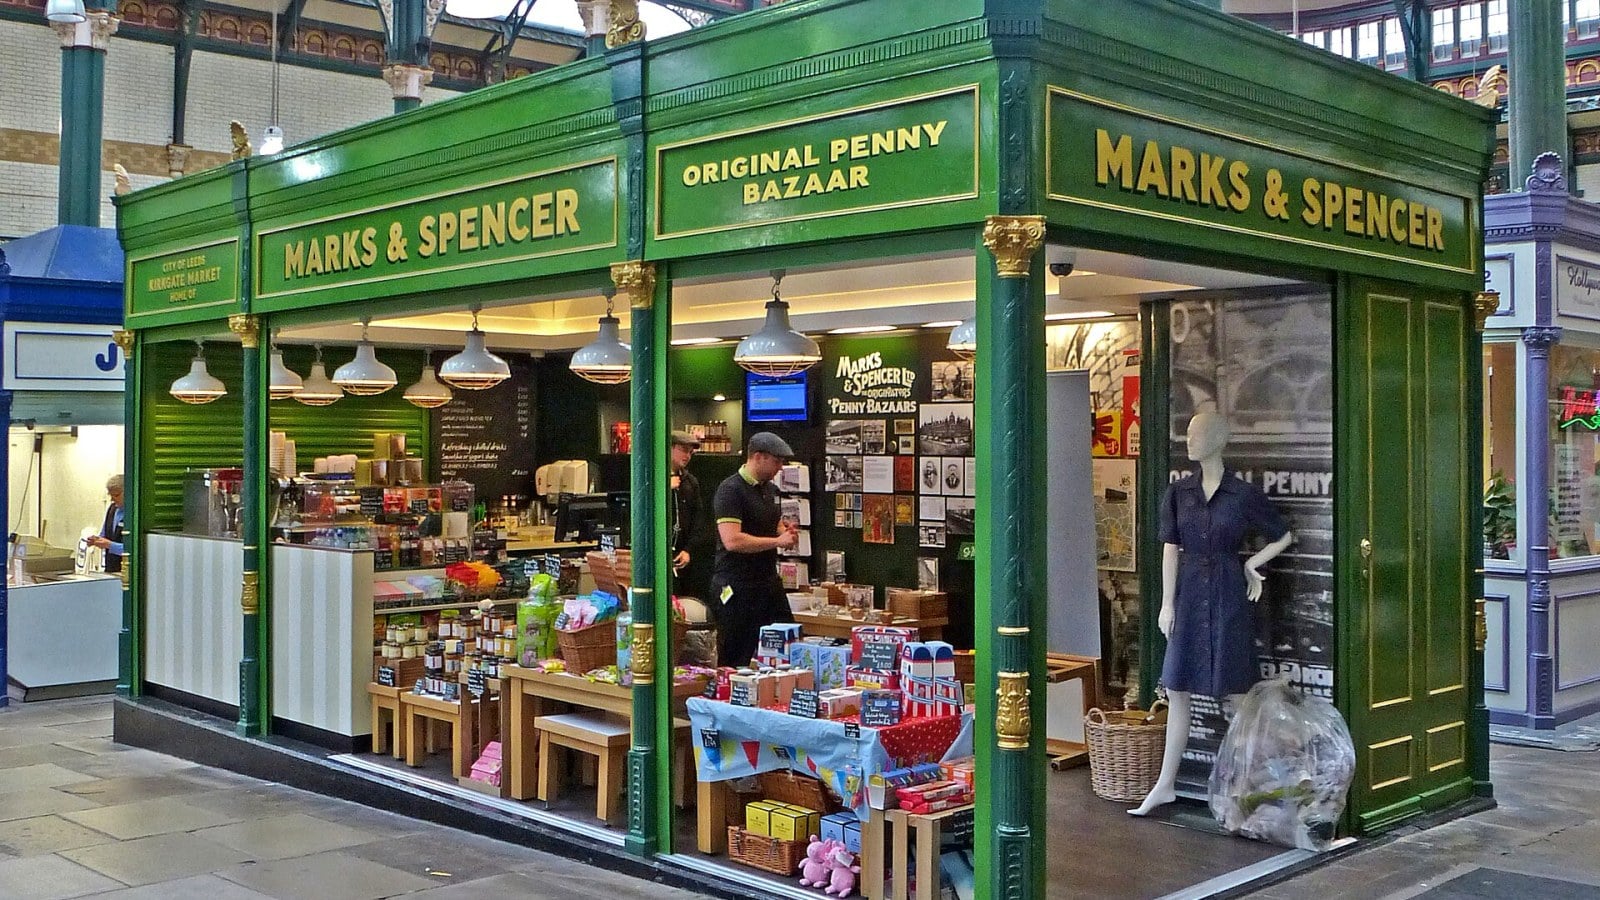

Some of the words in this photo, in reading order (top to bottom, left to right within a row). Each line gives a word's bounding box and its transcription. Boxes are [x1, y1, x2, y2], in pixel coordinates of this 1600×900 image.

[683, 144, 821, 187] ORIGINAL
[829, 120, 948, 163] PENNY
[743, 165, 870, 205] BAZAAR
[1095, 128, 1251, 213] MARKS
[1263, 168, 1290, 221] &
[1302, 177, 1445, 252] SPENCER
[284, 227, 378, 280] MARKS
[387, 221, 408, 263] &
[418, 188, 581, 258] SPENCER
[163, 261, 177, 272] CITY
[177, 259, 187, 271] OF
[187, 255, 205, 268] LEEDS
[148, 273, 186, 292] KIRKGATE
[187, 266, 221, 285] MARKET
[836, 351, 882, 379] MARKS
[843, 379, 854, 393] &
[852, 367, 901, 396] SPENCER
[831, 398, 866, 414] PENNY
[866, 398, 917, 414] BAZAARS
[1262, 470, 1333, 495] PENNY
